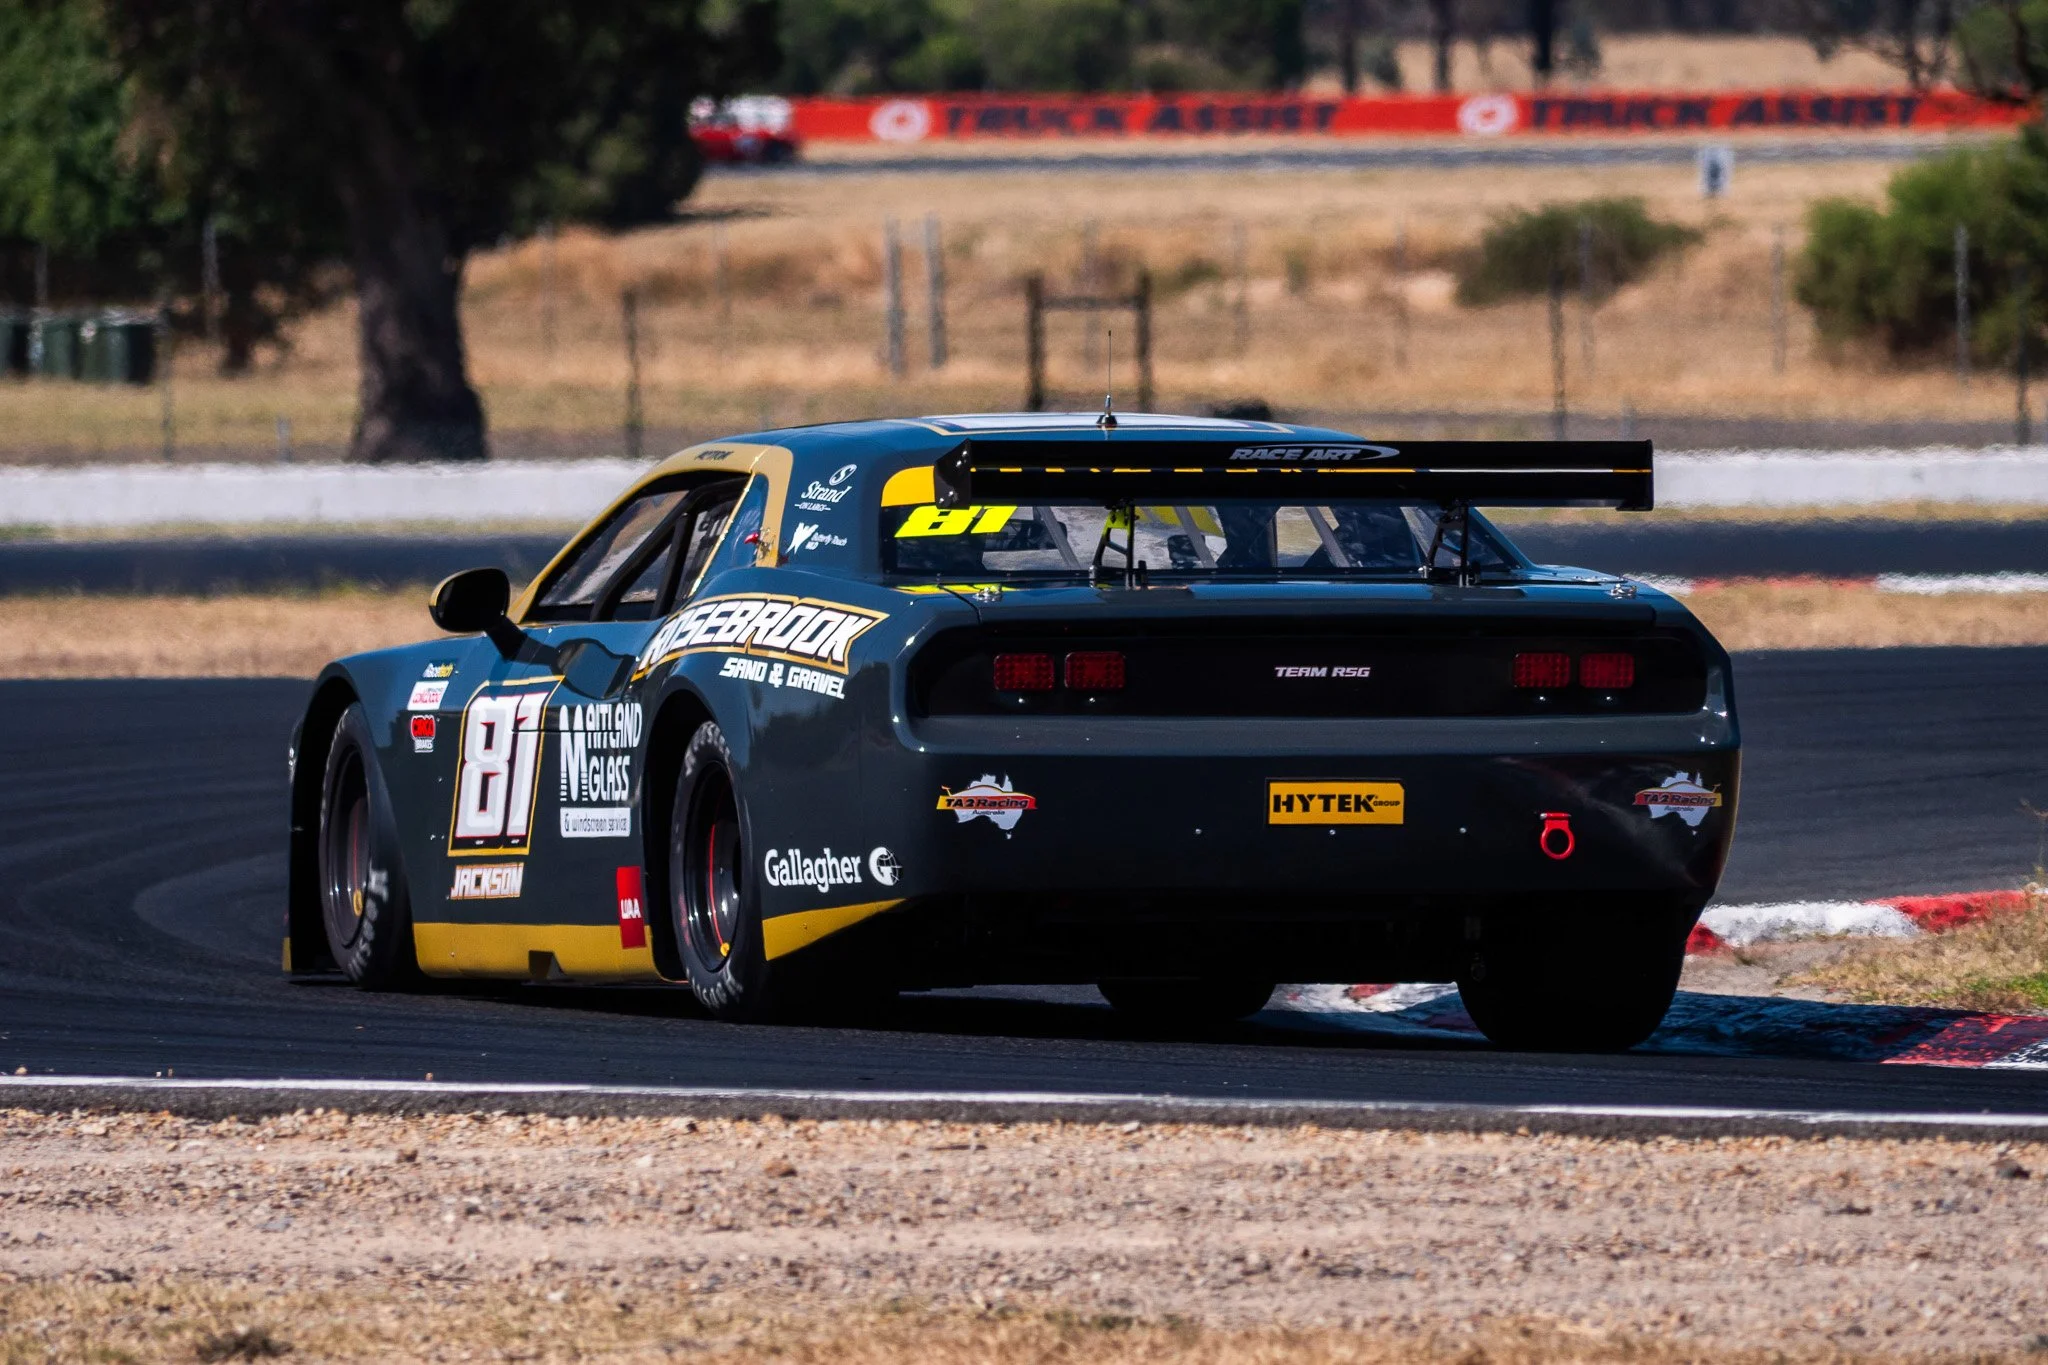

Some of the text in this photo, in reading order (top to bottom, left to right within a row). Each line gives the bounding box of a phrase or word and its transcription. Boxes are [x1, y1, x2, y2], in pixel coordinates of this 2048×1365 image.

[1229, 448, 1363, 460] RACE ART
[801, 481, 853, 503] Strand
[895, 505, 1018, 538] 81
[639, 600, 874, 671] ROSEBROOK
[719, 657, 846, 699] SAND & GRAVEL
[1275, 667, 1370, 677] TEAM RSG
[455, 691, 550, 838] 81
[588, 755, 631, 801] GLASS
[1273, 794, 1375, 813] HYTEK
[450, 864, 524, 899] JACKSON
[764, 847, 863, 893] Gallagher
